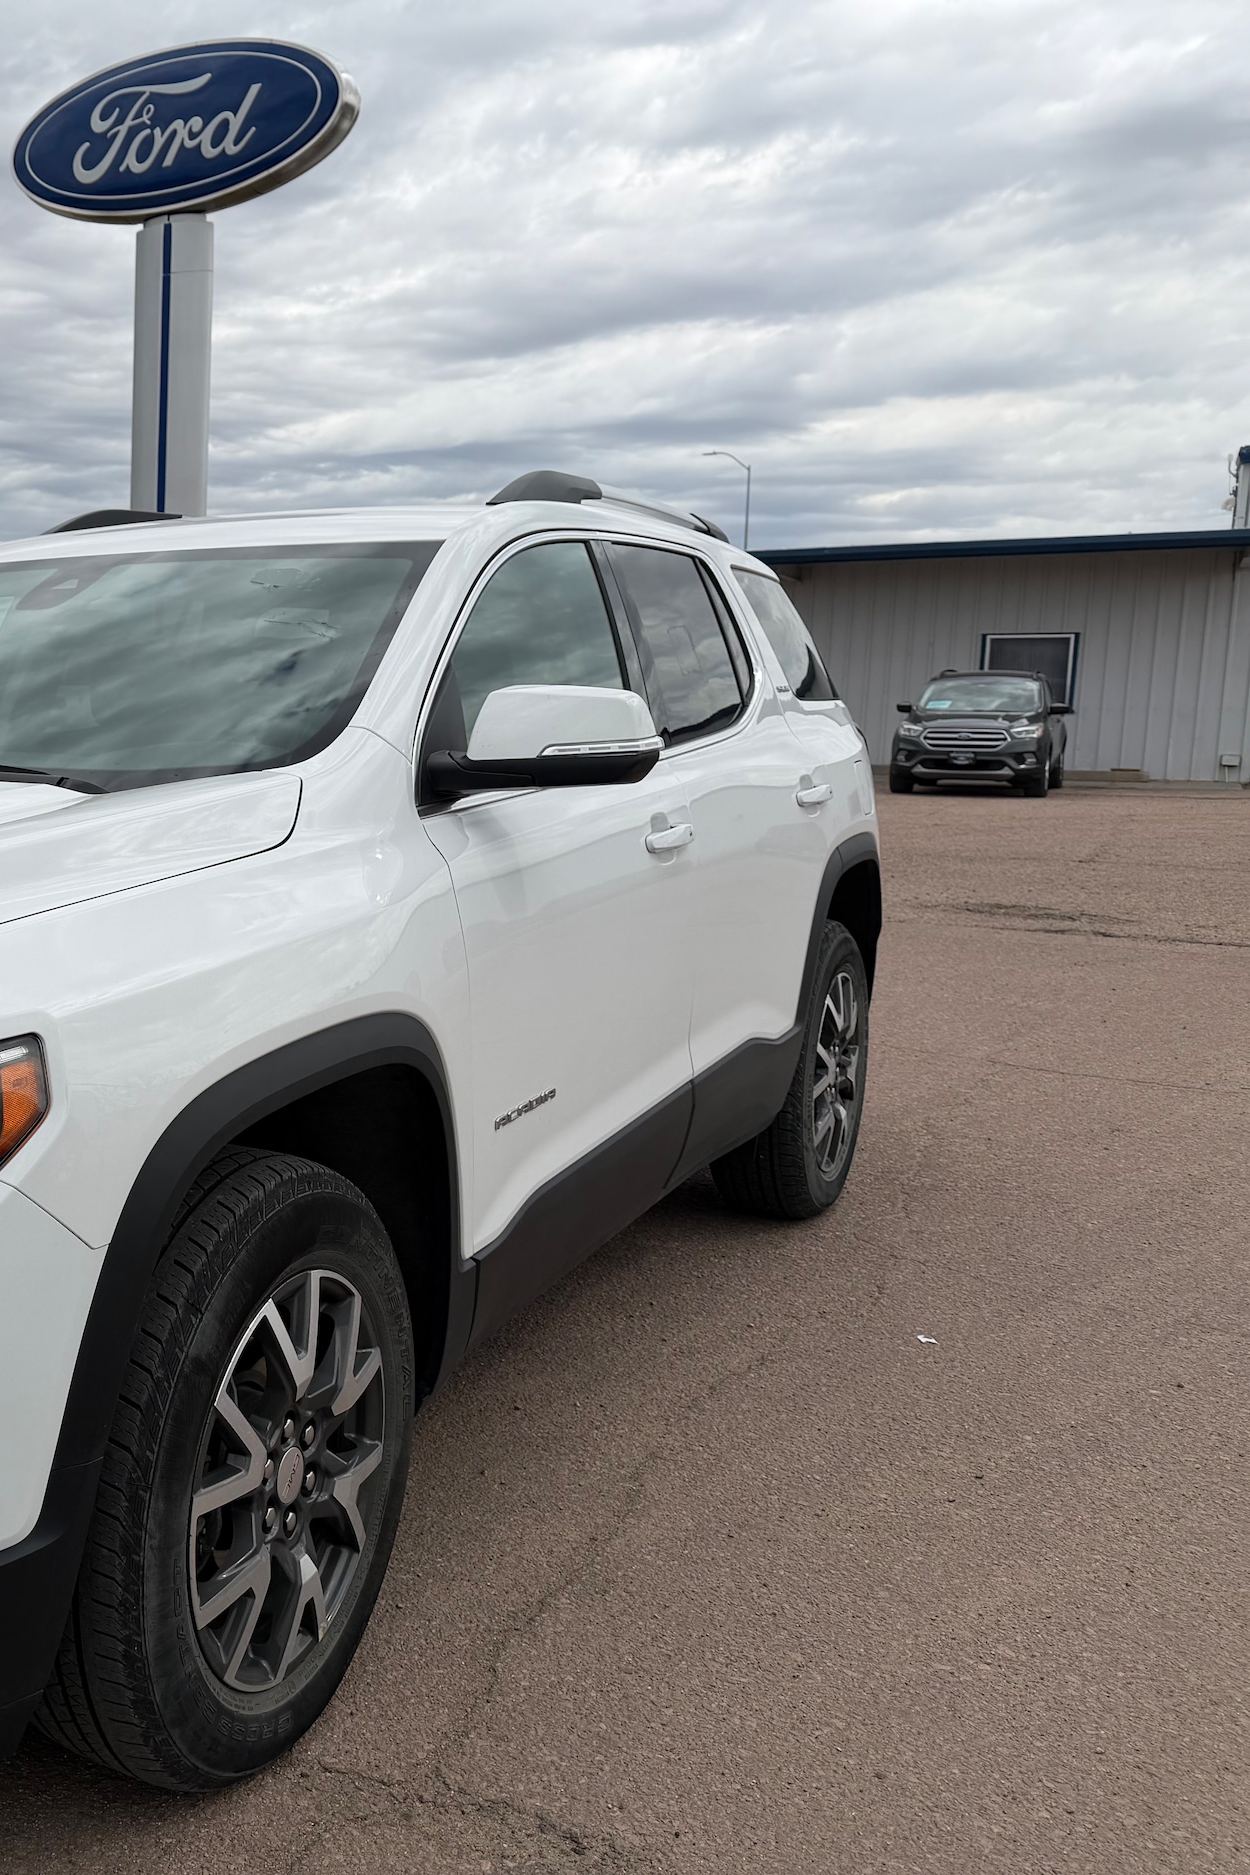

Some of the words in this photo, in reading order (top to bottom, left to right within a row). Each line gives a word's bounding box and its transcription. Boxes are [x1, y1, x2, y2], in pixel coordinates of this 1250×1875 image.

[72, 72, 262, 184] Ford
[494, 1087, 556, 1132] ACADIA
[316, 1223, 412, 1422] CONTINENTAL
[281, 1452, 301, 1499] GMC
